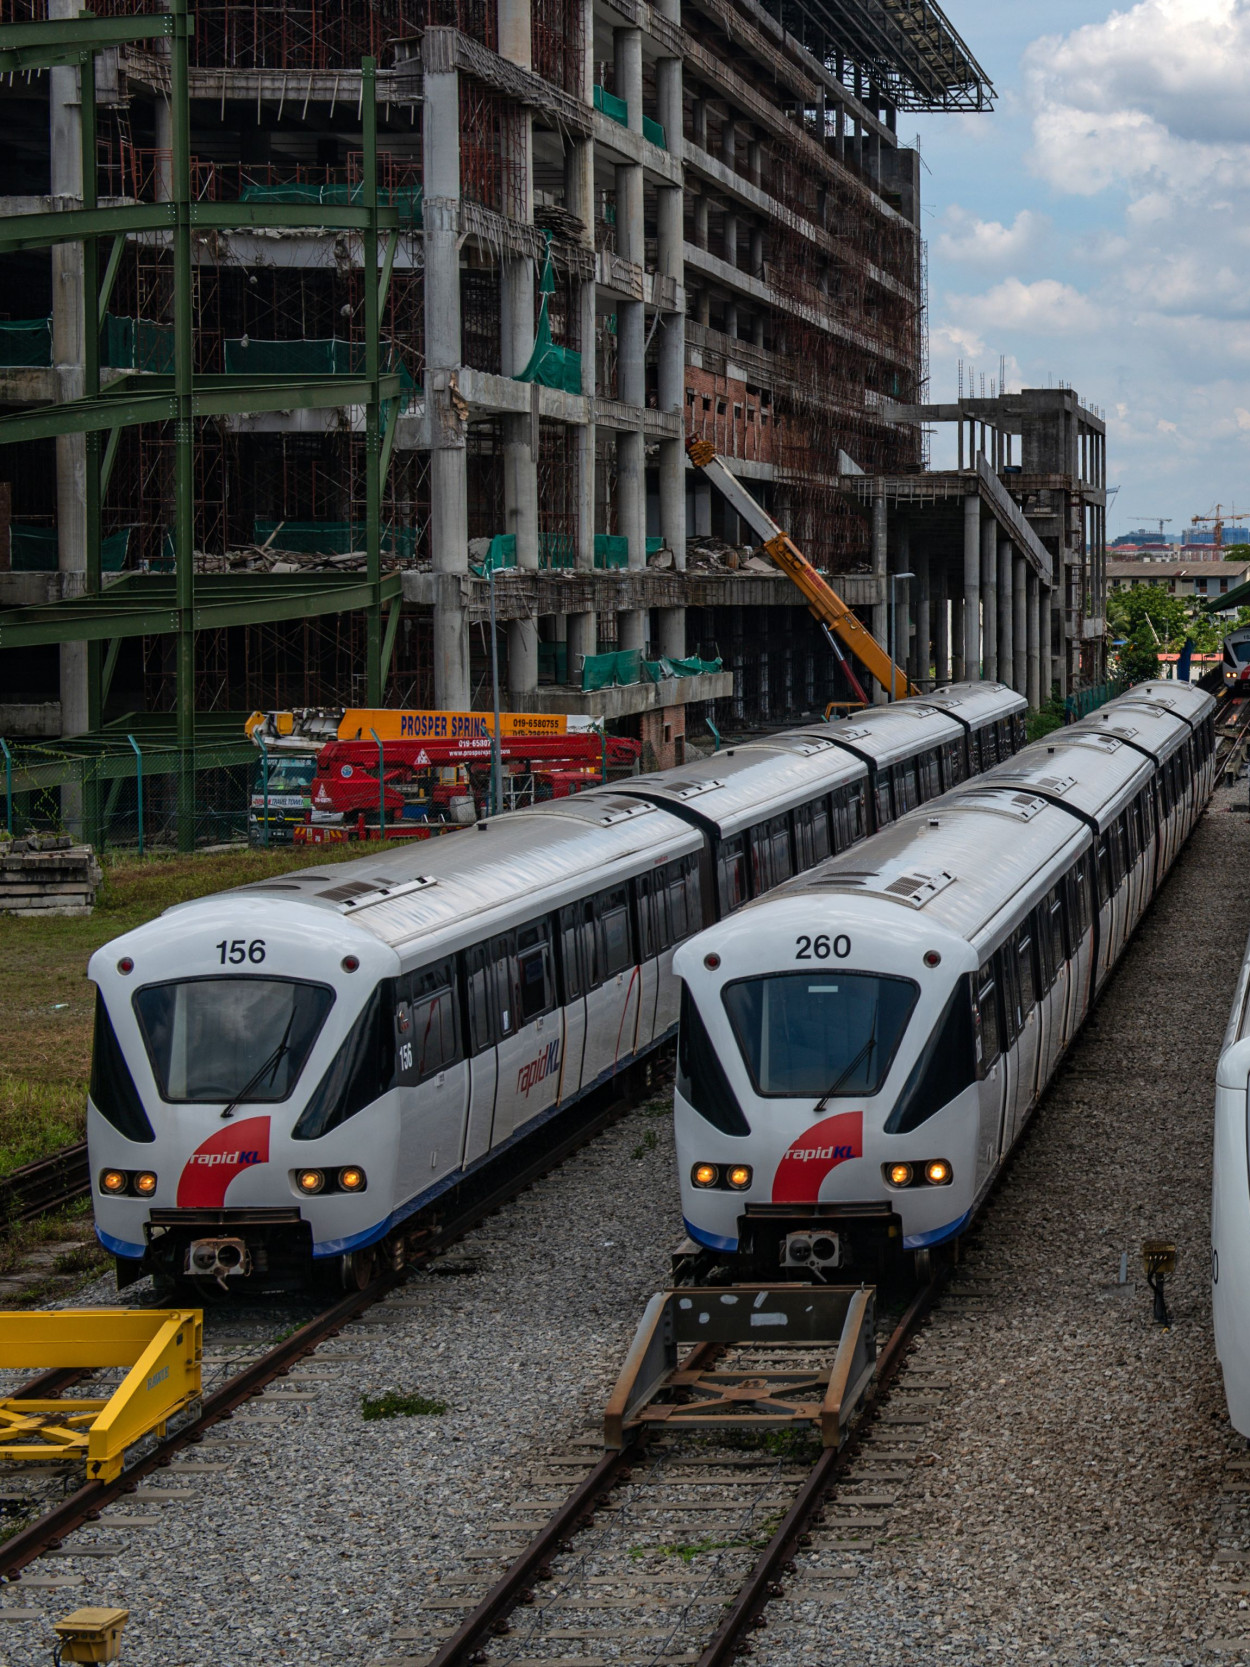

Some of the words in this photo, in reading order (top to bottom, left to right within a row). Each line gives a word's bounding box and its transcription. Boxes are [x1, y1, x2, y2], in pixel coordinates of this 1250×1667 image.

[400, 715, 447, 736] PROSPER
[513, 718, 559, 728] 019-6580755
[217, 939, 266, 965] 156
[795, 934, 851, 959] 260
[399, 1042, 413, 1072] 156
[516, 1038, 560, 1098] rapidKL
[190, 1150, 262, 1168] rapidKL
[785, 1145, 856, 1163] rapidKL
